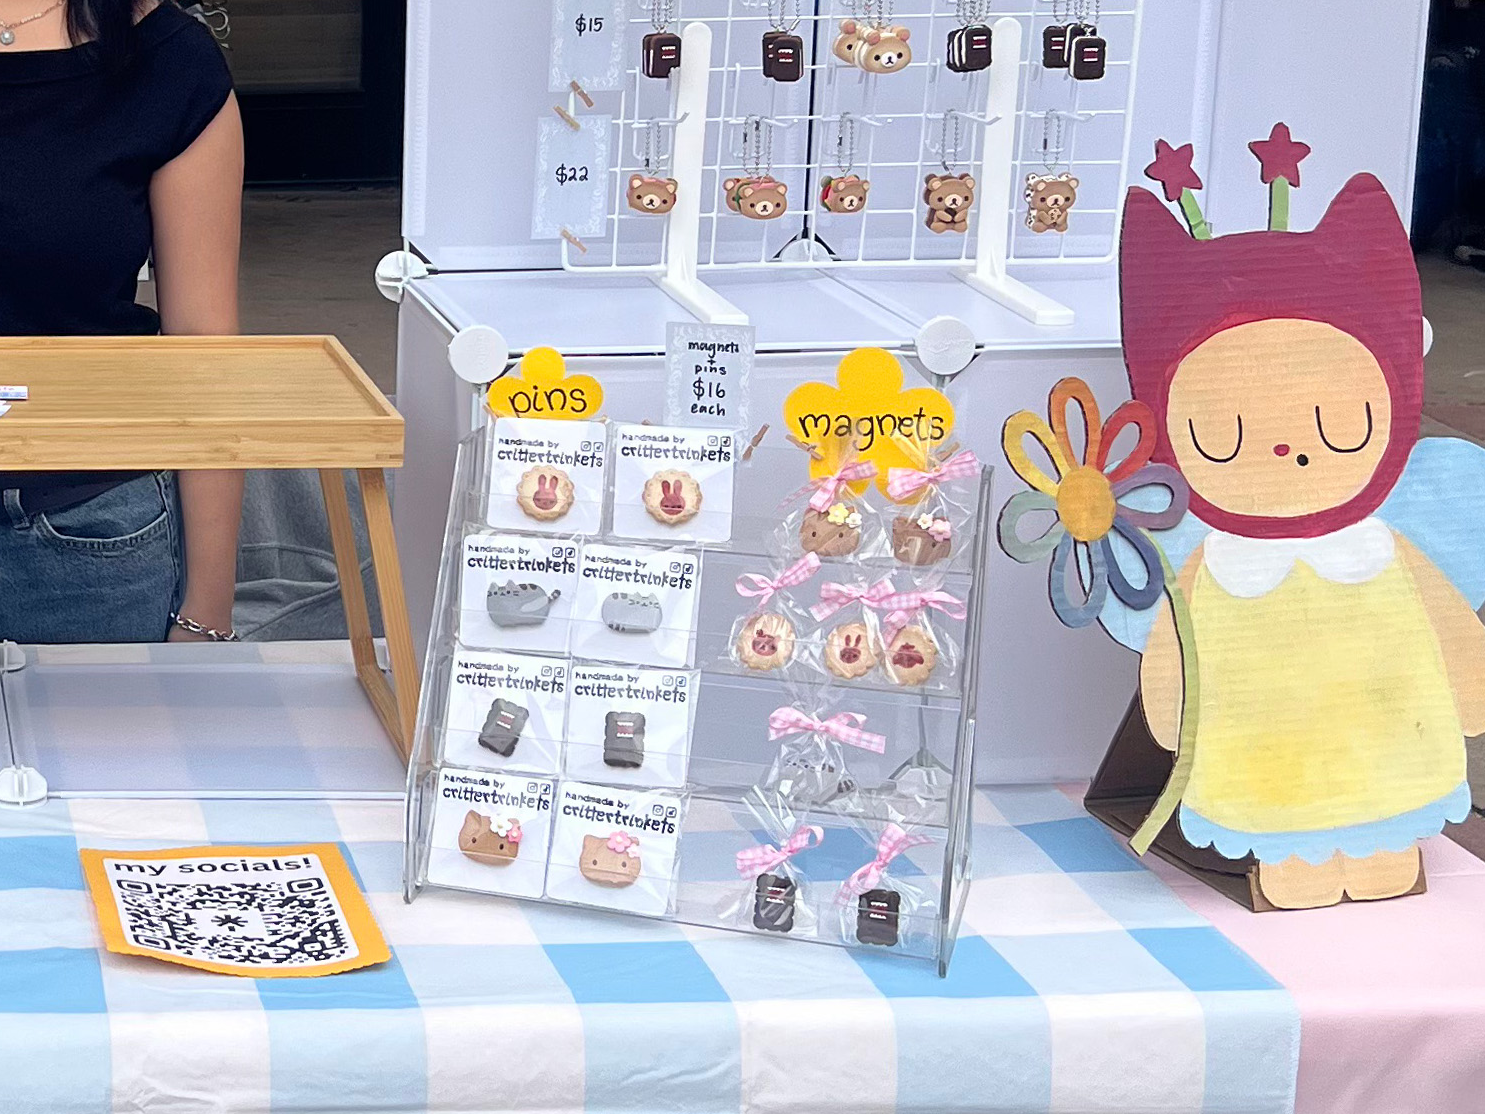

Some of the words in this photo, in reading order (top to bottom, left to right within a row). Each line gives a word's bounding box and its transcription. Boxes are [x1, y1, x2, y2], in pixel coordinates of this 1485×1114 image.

[575, 13, 604, 37] $15
[555, 163, 589, 186] $22
[687, 341, 740, 359] magnets
[694, 364, 727, 376] pins
[692, 377, 726, 401] $16
[508, 385, 588, 417] pins
[690, 403, 726, 417] each
[622, 433, 669, 443] handmade
[673, 435, 685, 445] by
[798, 406, 945, 452] magnets
[499, 438, 544, 448] handmade
[547, 440, 559, 449] by
[621, 443, 731, 463] crittertrinkets
[497, 448, 604, 468] crittertrinkets
[468, 544, 515, 554] handmade
[518, 546, 530, 556] by
[467, 555, 576, 575] crittertrinkets
[585, 554, 632, 566] handmade
[635, 558, 648, 569] by
[582, 565, 692, 590] crittertrinkets
[457, 660, 504, 671] handmade
[507, 664, 520, 674] by
[456, 671, 564, 693] crittertrinkets
[575, 671, 623, 682] handmade
[627, 674, 639, 684] by
[574, 683, 686, 703] crittertrinkets
[444, 774, 490, 786] handmade
[493, 778, 505, 789] by
[443, 786, 550, 811] crittertrinkets
[565, 791, 614, 807] handmade
[617, 800, 630, 811] by
[562, 803, 675, 834] crittertrinkets
[114, 862, 167, 877] my
[178, 857, 312, 873] socials!
